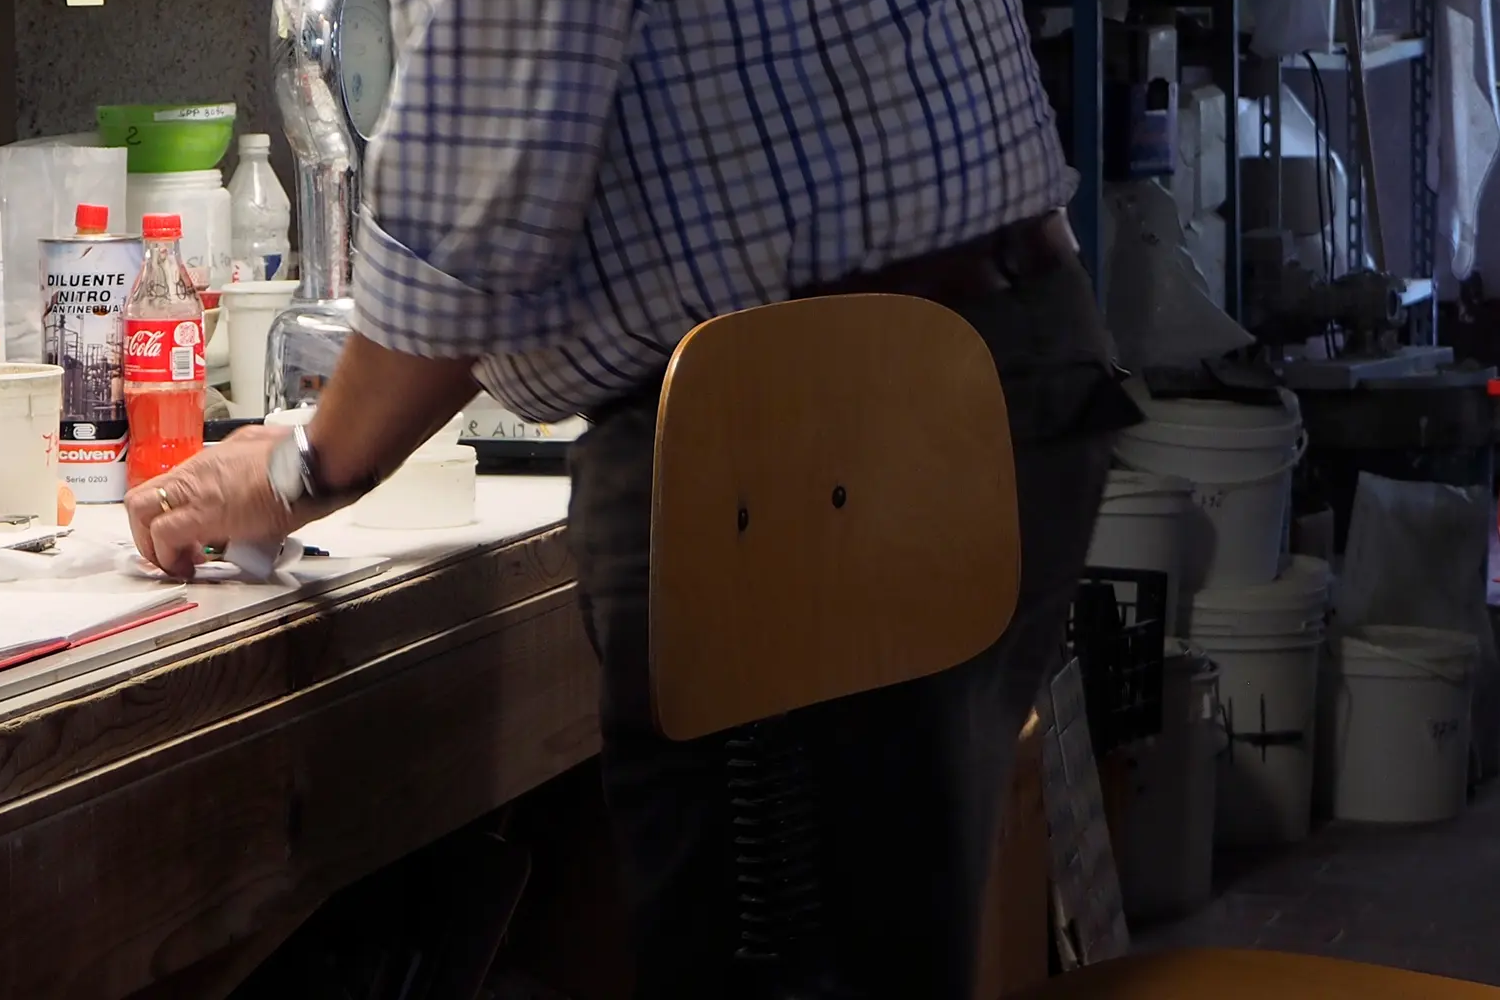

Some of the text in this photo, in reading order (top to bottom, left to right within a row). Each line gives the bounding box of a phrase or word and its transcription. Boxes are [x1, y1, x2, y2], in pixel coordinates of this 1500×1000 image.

[47, 274, 125, 286] DILUENTE
[59, 290, 111, 302] NITRO
[59, 449, 115, 460] colven
